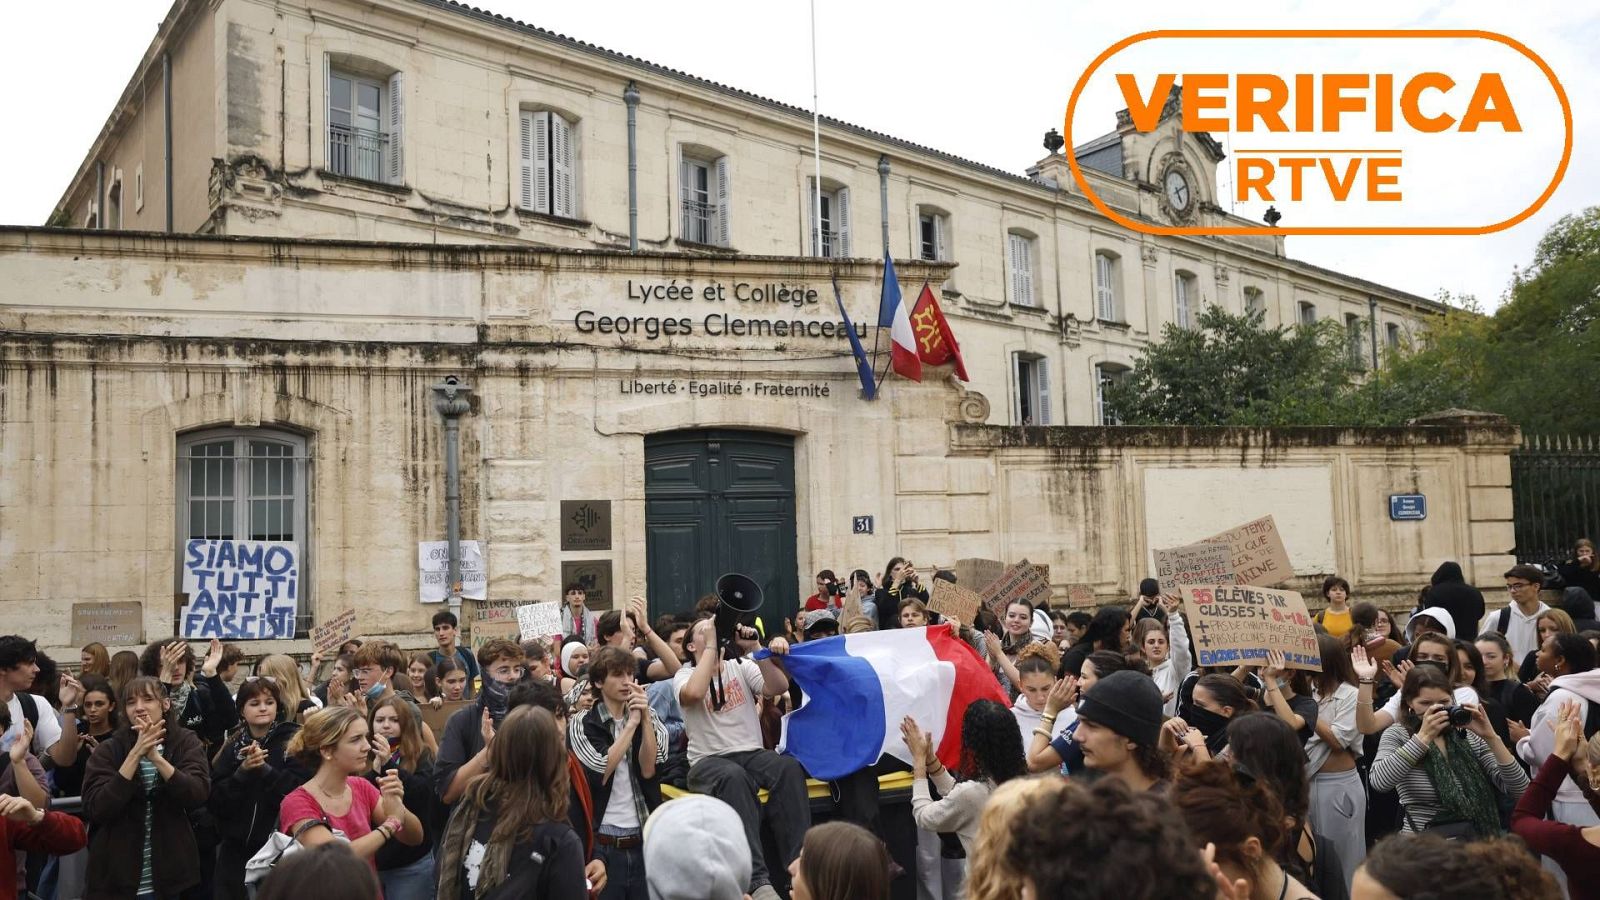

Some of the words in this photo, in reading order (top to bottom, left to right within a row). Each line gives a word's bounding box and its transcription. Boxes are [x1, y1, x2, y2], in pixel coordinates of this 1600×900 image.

[628, 279, 694, 304] Lycée
[703, 283, 725, 301] et
[734, 282, 818, 308] Collège
[574, 310, 693, 340] Georges
[704, 313, 867, 339] Clemenceau
[620, 380, 677, 395] Liberté
[689, 381, 742, 397] Egalité
[754, 382, 830, 397] Fraternité
[857, 518, 869, 532] 31
[1242, 519, 1273, 537] TEMPS
[1026, 582, 1048, 600] GAZER
[1191, 588, 1214, 605] 35
[1214, 585, 1265, 605] ÉLÈVES
[1266, 593, 1288, 608] PAR
[487, 609, 506, 619] BAC
[1199, 604, 1256, 618] CLASSES
